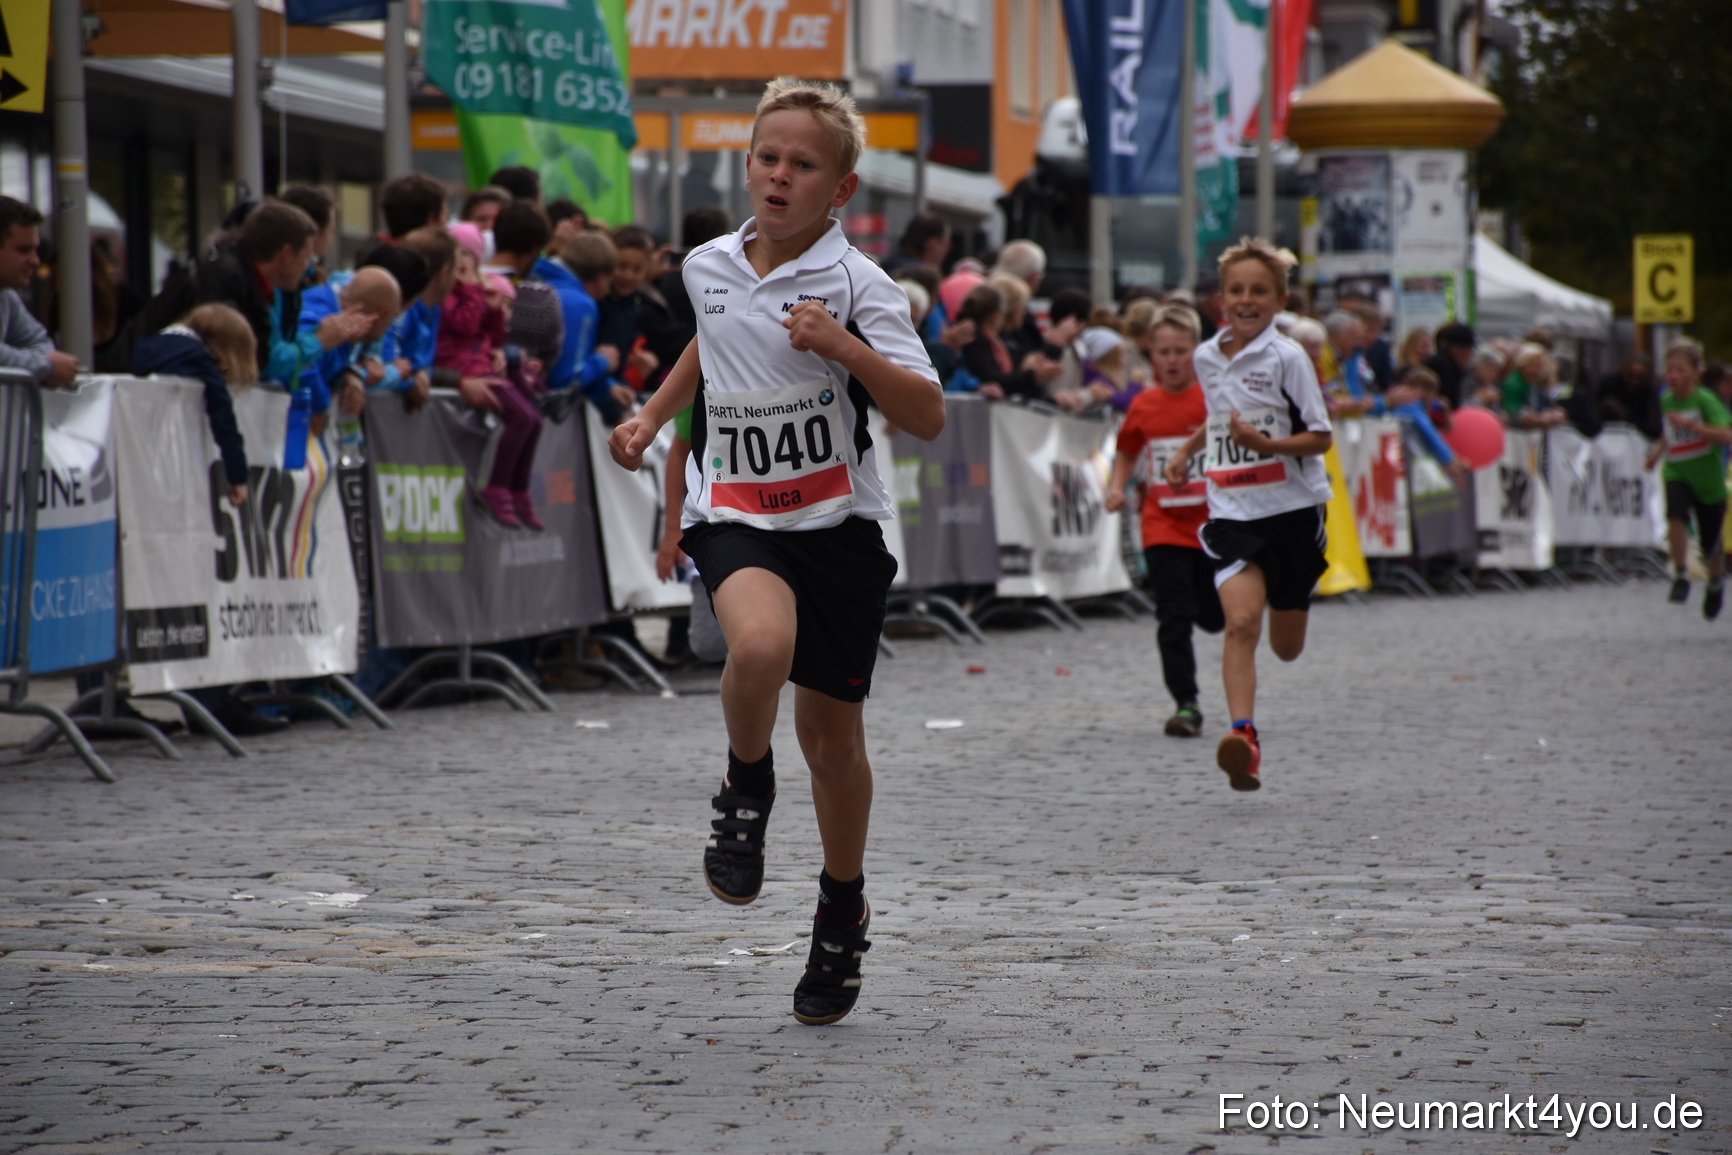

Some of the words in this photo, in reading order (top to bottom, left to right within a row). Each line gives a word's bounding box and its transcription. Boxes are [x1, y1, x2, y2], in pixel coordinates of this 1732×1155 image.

[1648, 262, 1677, 304] C
[704, 302, 725, 314] Luca
[708, 405, 742, 419] PARTL
[744, 398, 814, 418] Neumarkt
[718, 414, 833, 476] 7040
[716, 472, 722, 482] 6
[379, 473, 465, 533] BOCK
[758, 489, 802, 509] Luca
